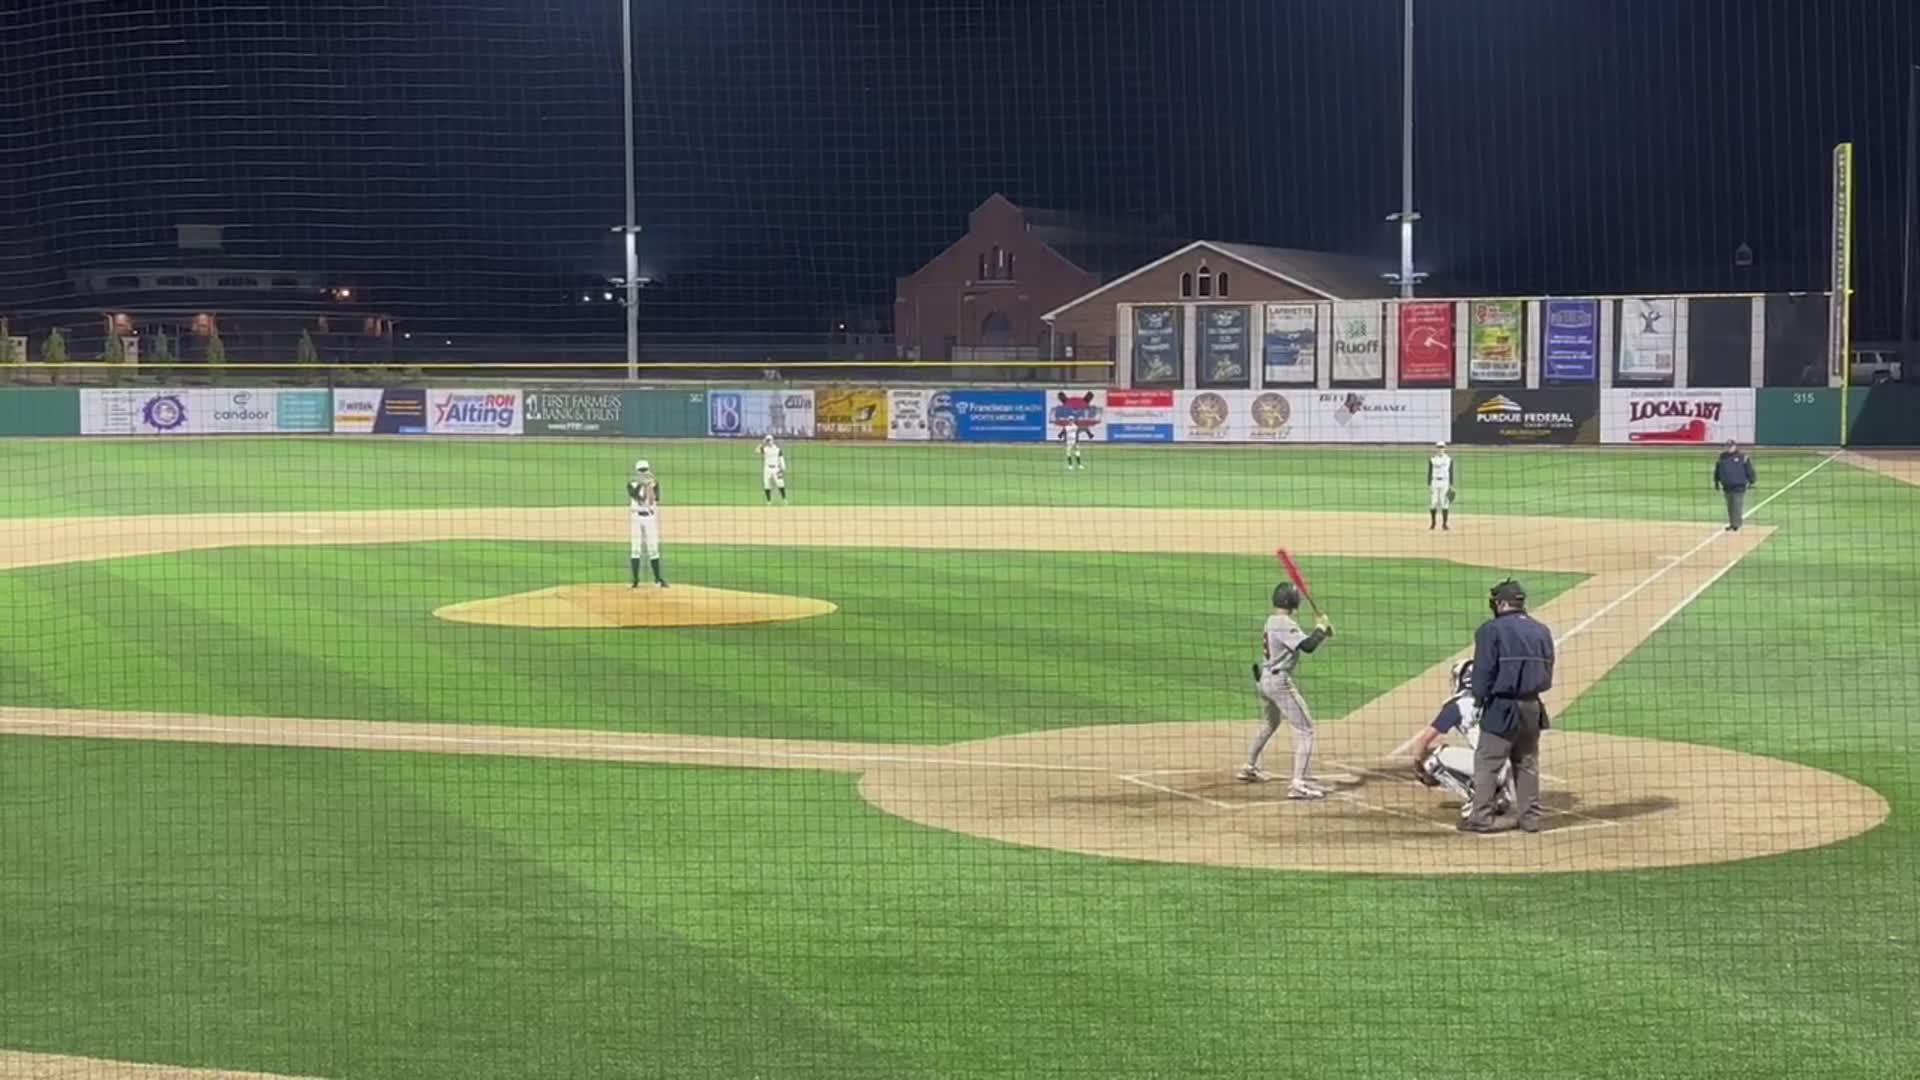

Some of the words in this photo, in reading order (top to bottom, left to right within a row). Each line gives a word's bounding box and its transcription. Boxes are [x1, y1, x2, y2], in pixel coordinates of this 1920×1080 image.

[1335, 339, 1379, 354] Ruoff
[1793, 392, 1815, 404] 315
[214, 409, 270, 420] candoor
[446, 403, 513, 428] Alting
[1477, 413, 1522, 423] PURDUE
[1524, 412, 1573, 422] FEDERAL
[1630, 401, 1694, 422] LOCAL
